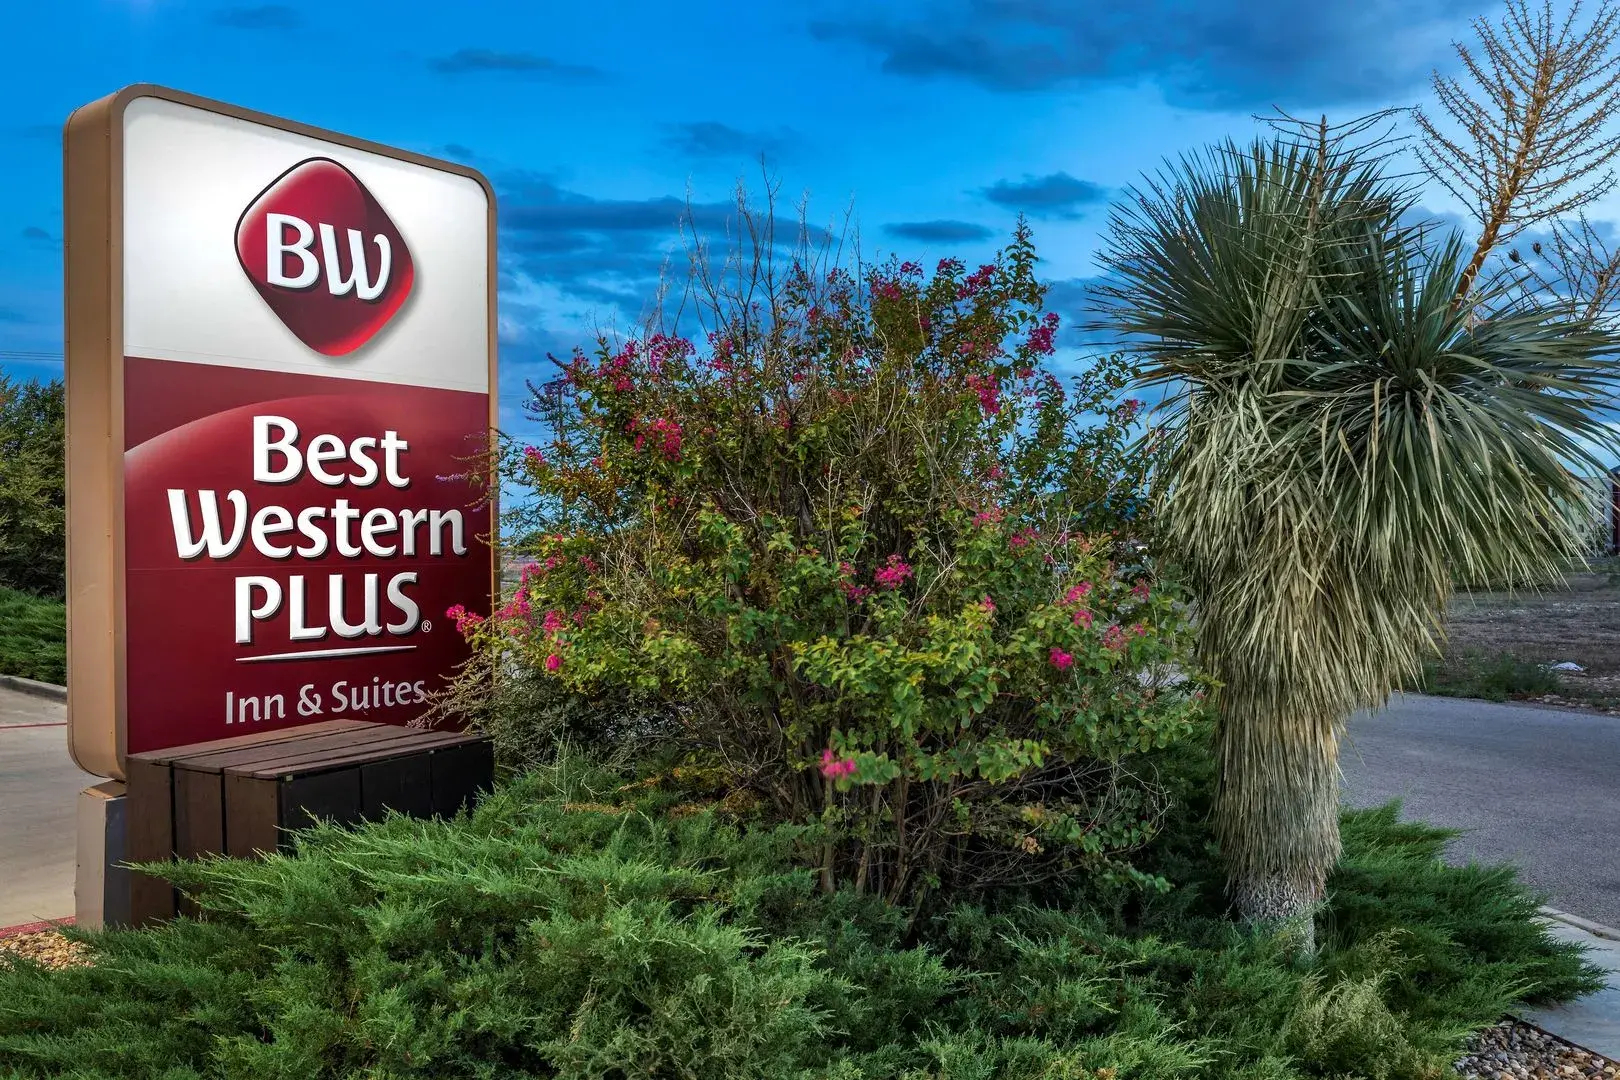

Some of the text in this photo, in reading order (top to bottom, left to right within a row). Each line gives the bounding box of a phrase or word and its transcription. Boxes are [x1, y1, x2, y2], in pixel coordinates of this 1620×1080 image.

[265, 212, 393, 301] BW
[253, 415, 410, 488] Best
[167, 488, 467, 559] Western
[226, 677, 425, 724] Inn & Suites
